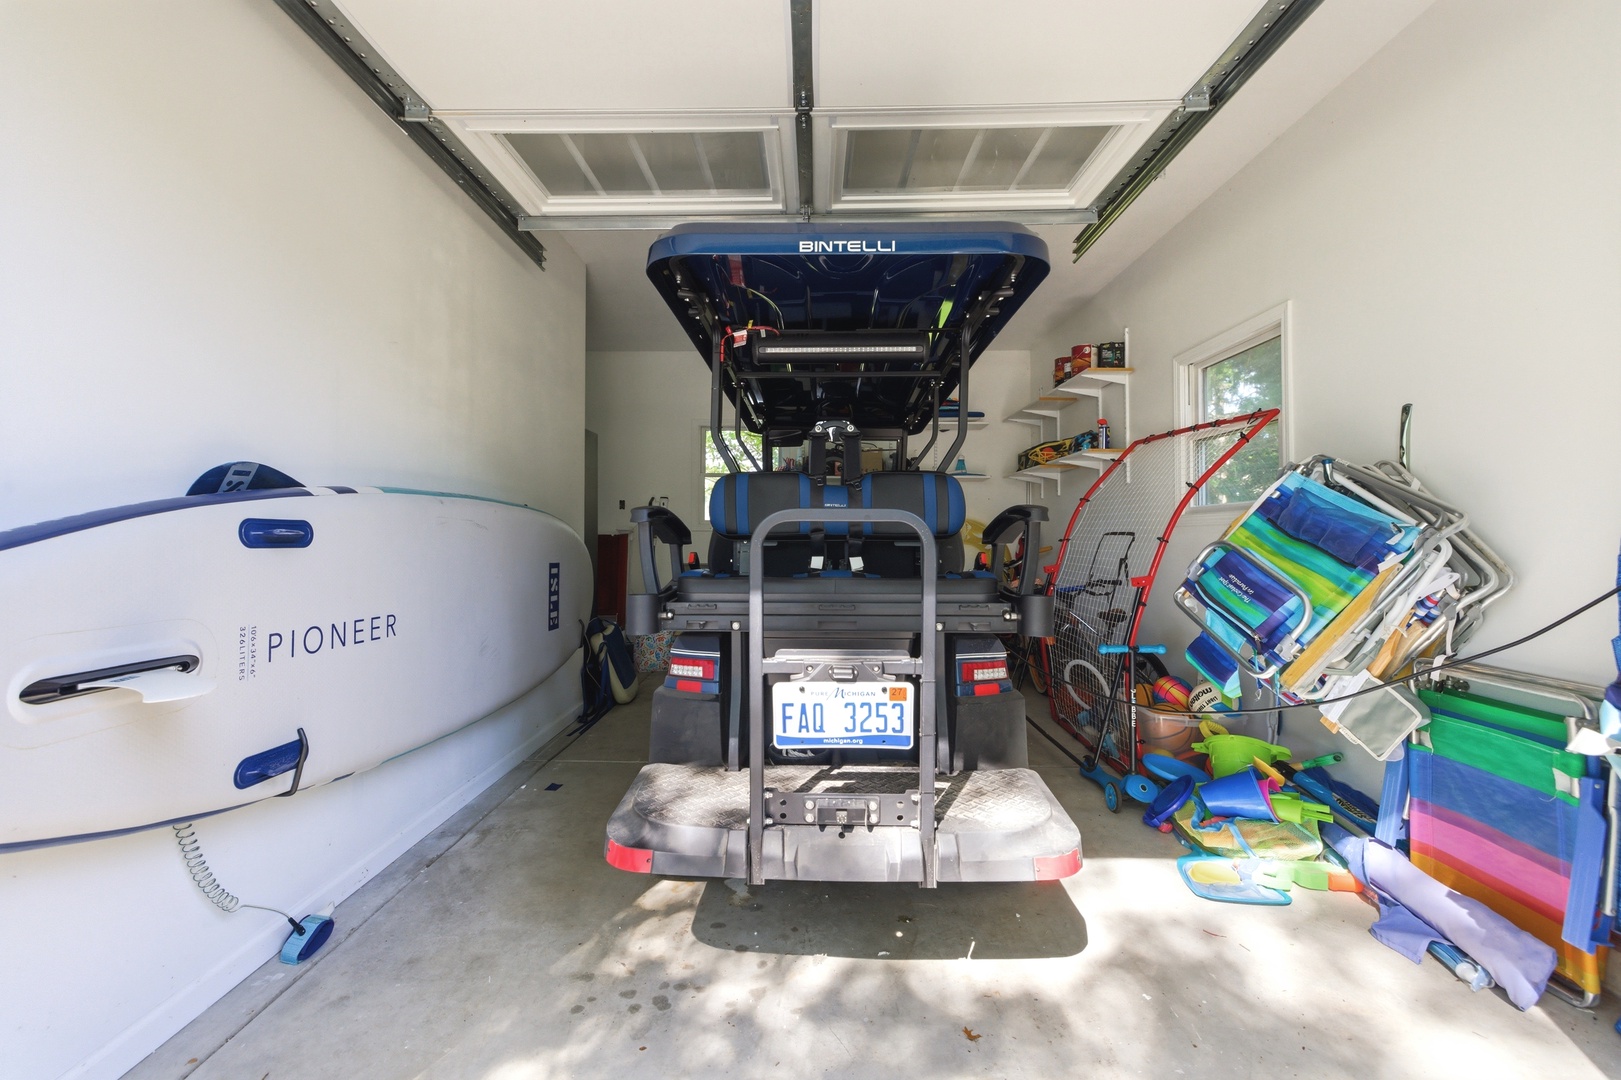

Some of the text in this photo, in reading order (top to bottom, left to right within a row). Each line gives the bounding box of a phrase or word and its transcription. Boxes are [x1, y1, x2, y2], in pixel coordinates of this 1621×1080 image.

[799, 240, 896, 252] BINTELLI
[268, 614, 397, 662] PIONEER
[829, 687, 876, 699] MICHIGAN
[891, 687, 903, 696] 27
[1190, 687, 1213, 708] molten
[782, 702, 904, 733] FAQ 3253
